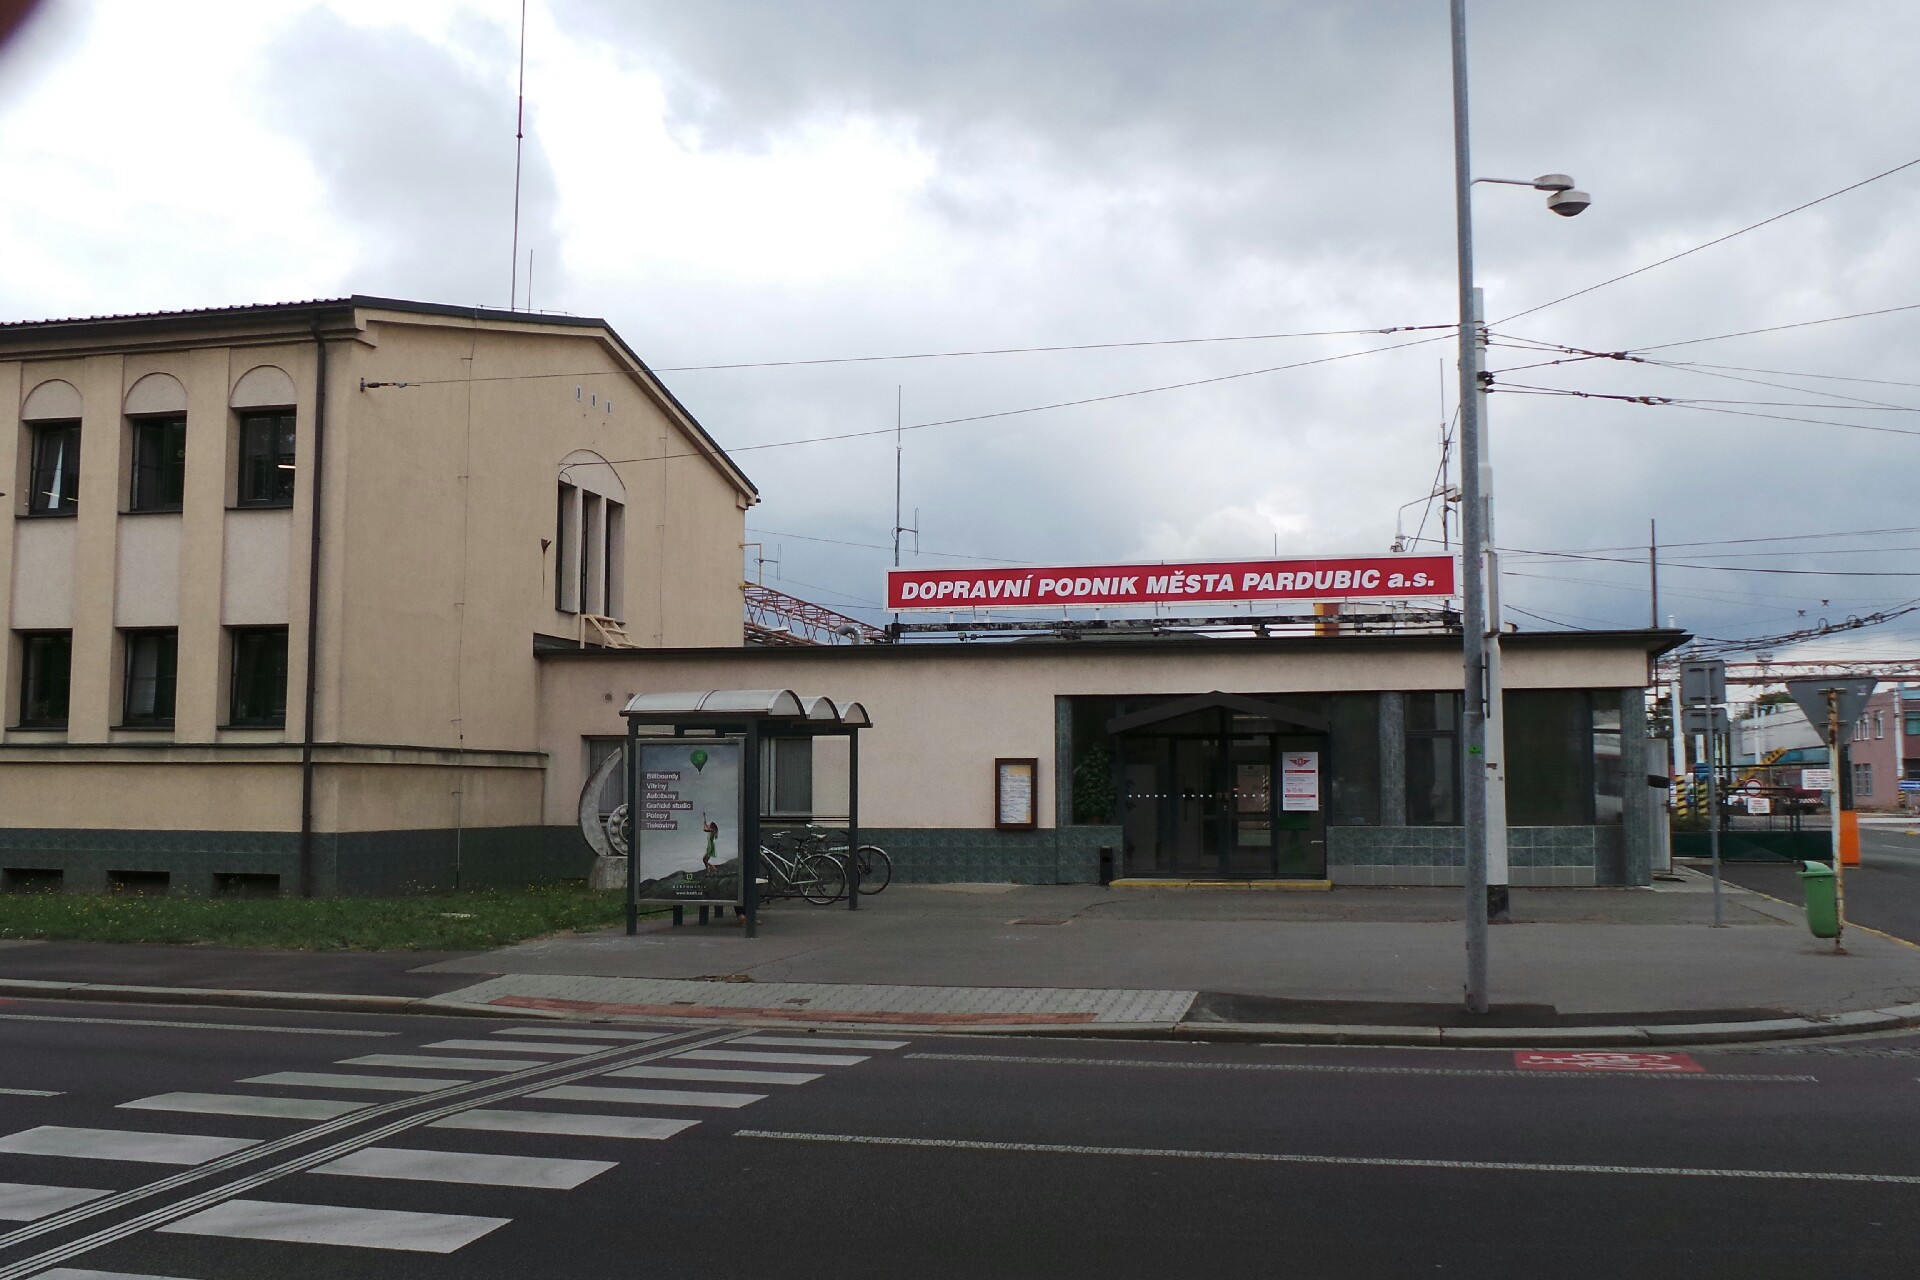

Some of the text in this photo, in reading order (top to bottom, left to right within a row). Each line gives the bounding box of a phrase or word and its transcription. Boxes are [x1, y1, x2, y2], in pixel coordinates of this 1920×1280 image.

[901, 569, 1435, 600] DOPRAVNÍ PODNIK MĚSTA PARDUBIC a.s.
[646, 812, 668, 820] Polepy
